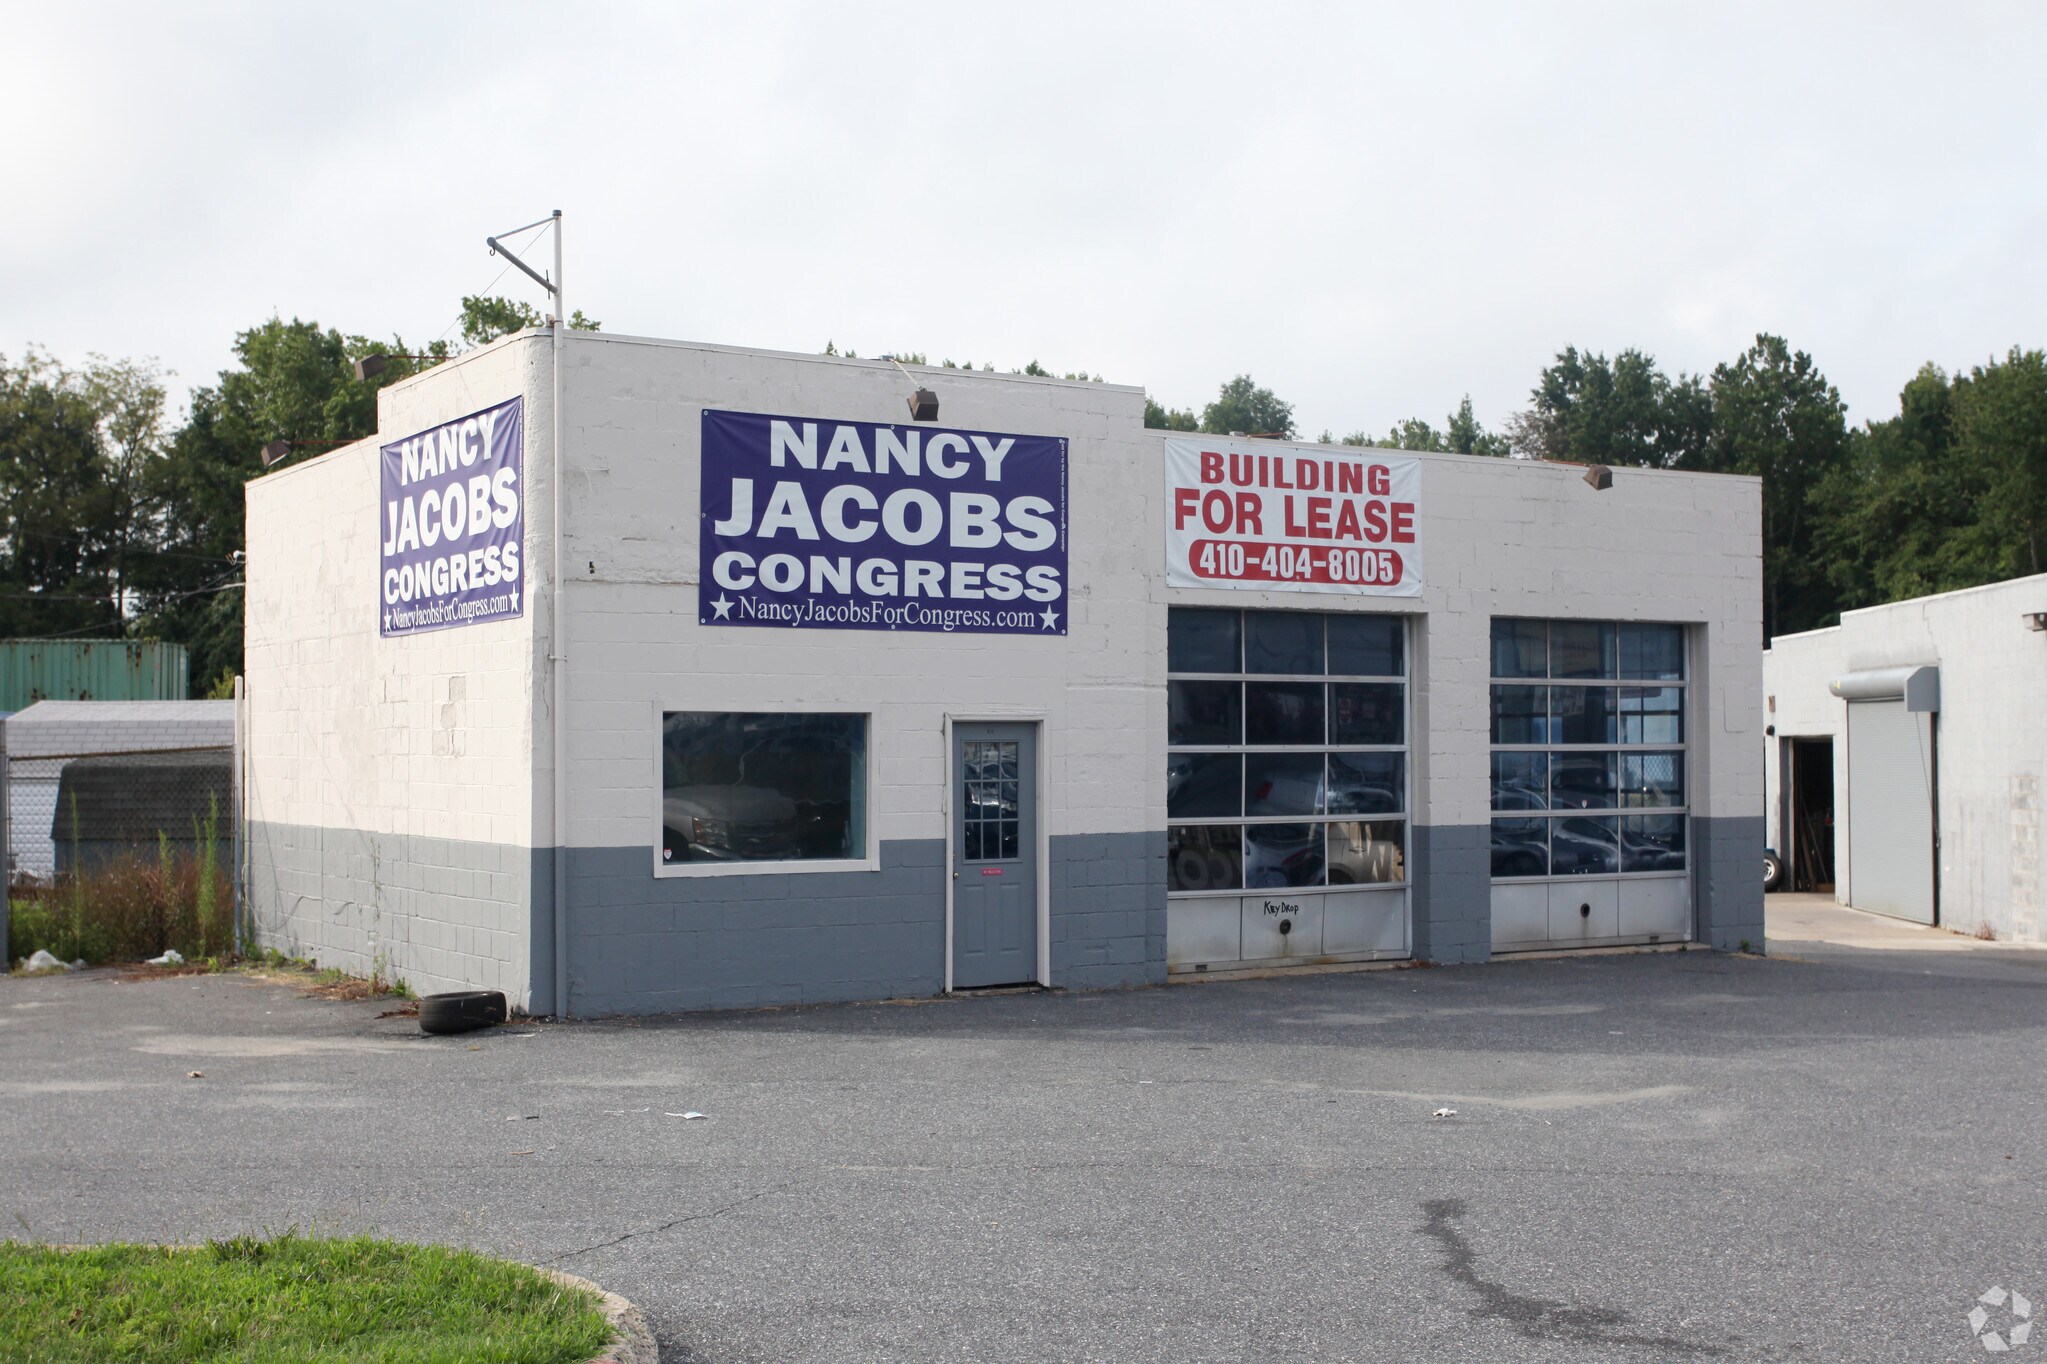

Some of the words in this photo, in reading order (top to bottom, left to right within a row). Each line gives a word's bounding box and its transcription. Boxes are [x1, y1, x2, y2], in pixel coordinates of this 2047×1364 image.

[401, 409, 500, 486] NANCY
[770, 420, 1016, 482] NANCY
[1200, 451, 1390, 496] BUILDING
[384, 467, 518, 556] JACOBS
[714, 478, 1057, 551] JACOBS
[1175, 487, 1263, 535] FOR
[1284, 495, 1415, 543] LEASE
[384, 541, 519, 605] CONGRESS
[712, 551, 1062, 602] CONGRESS
[1200, 543, 1394, 583] 410-404-8005
[392, 594, 509, 632] NancyJacobsForCongress.com
[739, 595, 1036, 631] NancyJacobsForCongress.com
